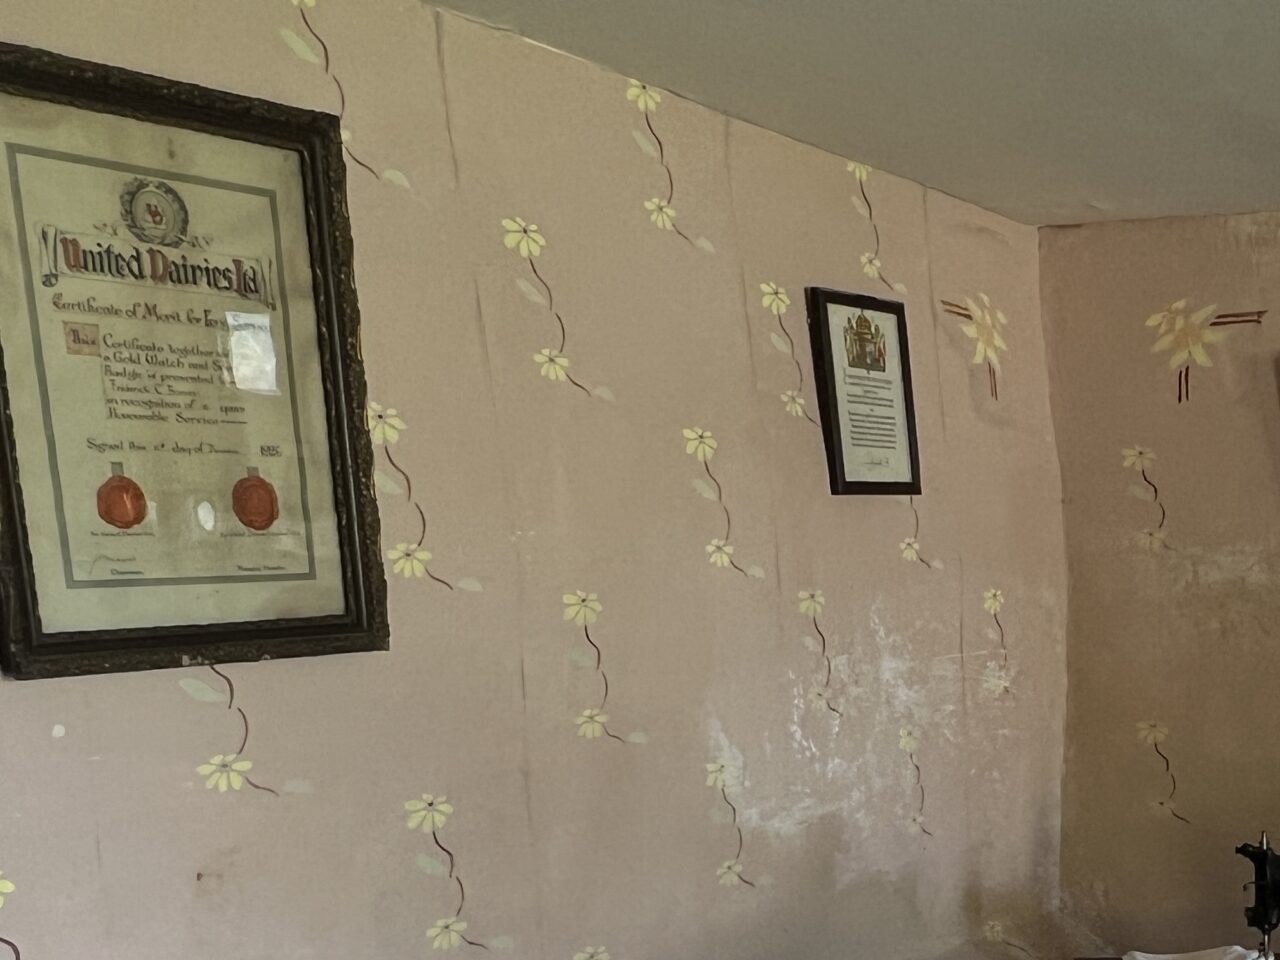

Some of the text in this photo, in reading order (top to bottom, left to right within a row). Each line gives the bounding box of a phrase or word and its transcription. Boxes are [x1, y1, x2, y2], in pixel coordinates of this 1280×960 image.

[60, 236, 145, 280] United
[146, 247, 233, 291] Dairies
[52, 292, 123, 316] Certificate
[125, 302, 141, 318] of
[142, 301, 182, 324] Merit
[102, 332, 164, 352] Certificate
[166, 342, 215, 359] together
[113, 351, 140, 366] Gold
[145, 352, 184, 369] Watch
